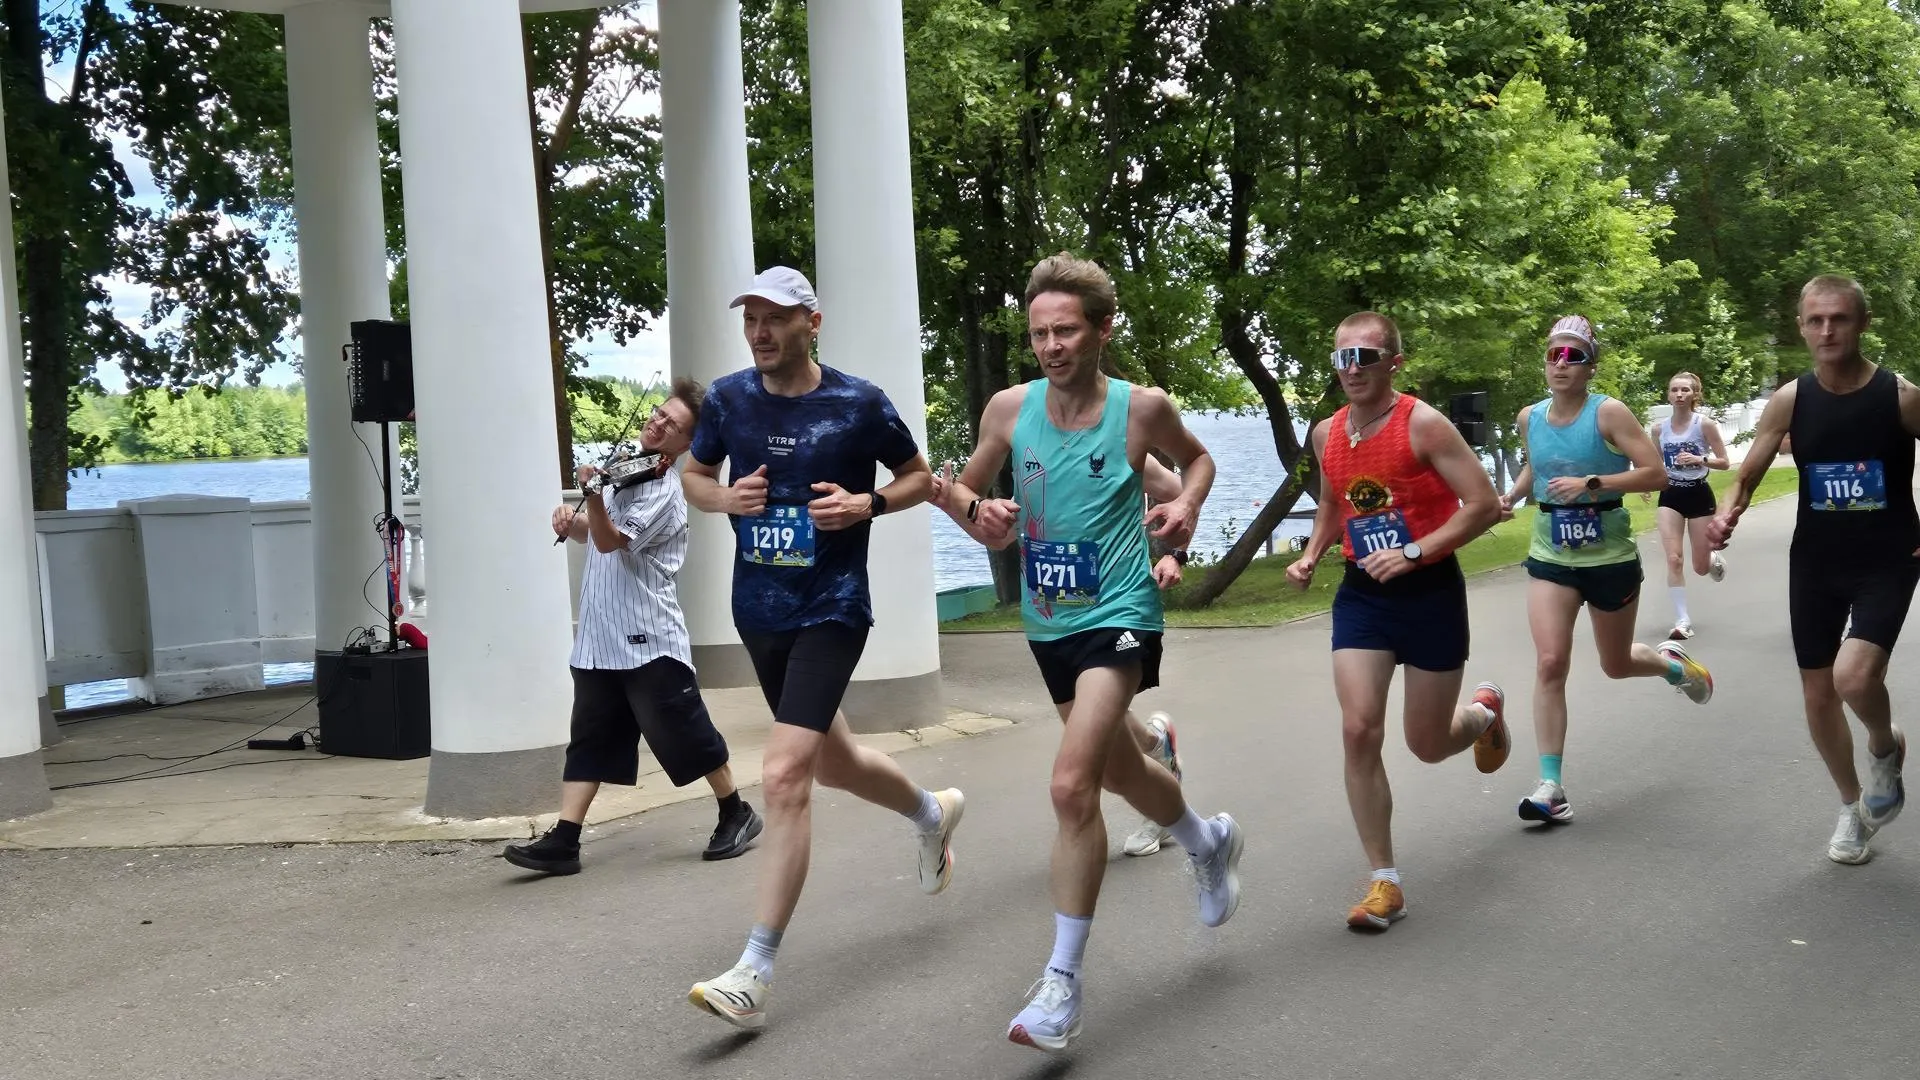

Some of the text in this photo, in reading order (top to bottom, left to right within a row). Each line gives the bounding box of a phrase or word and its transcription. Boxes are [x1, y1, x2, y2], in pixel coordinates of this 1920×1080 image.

[1824, 479, 1864, 498] 1116
[788, 507, 797, 516] B
[751, 526, 795, 550] 1219
[1559, 522, 1598, 540] 1184
[1068, 543, 1078, 553] B
[1363, 529, 1402, 553] 1112
[1034, 561, 1077, 588] 1271
